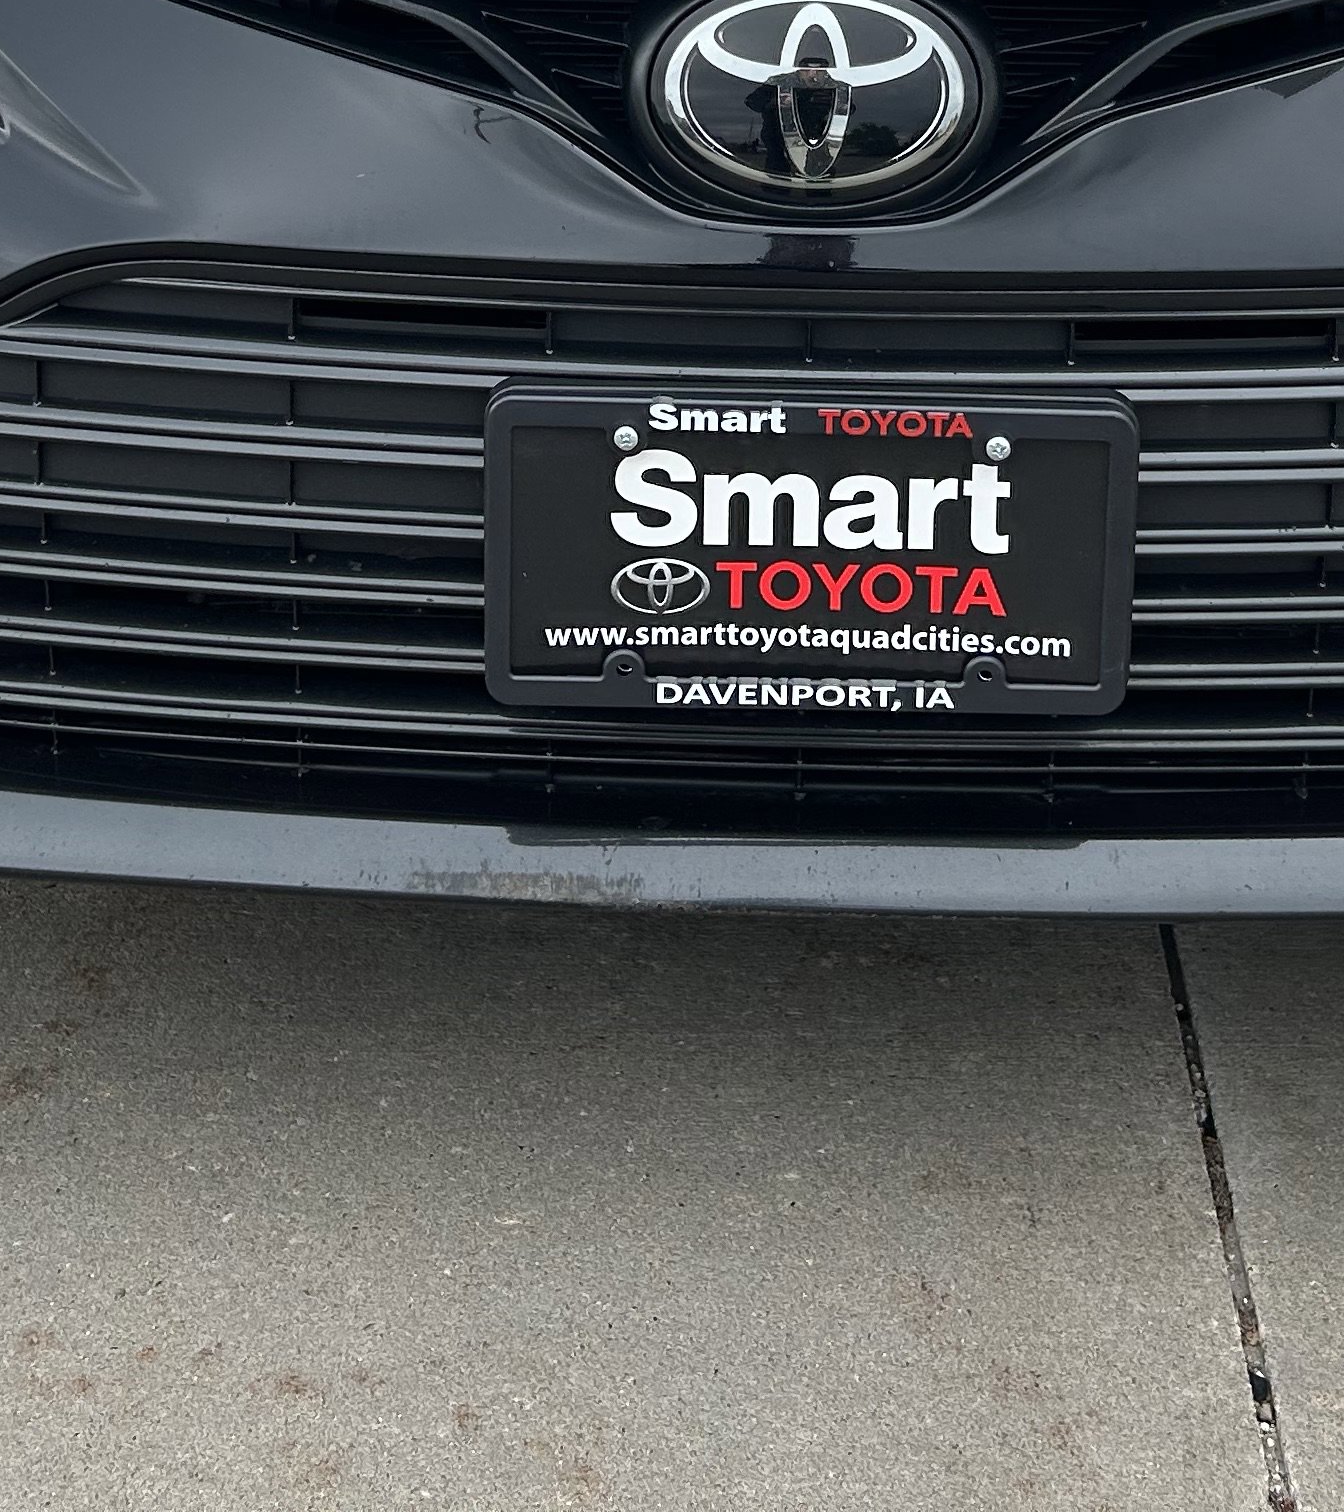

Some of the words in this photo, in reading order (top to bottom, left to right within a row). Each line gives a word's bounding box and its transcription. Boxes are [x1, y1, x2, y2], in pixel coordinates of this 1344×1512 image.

[648, 402, 787, 435] Smart
[818, 409, 973, 438] TOYOTA
[610, 450, 1011, 555] Smart
[716, 560, 1007, 617] TOYOTA
[544, 624, 1071, 658] www.smarttoyotaquadcities.com
[656, 683, 902, 712] DAVENPORT,
[915, 687, 955, 709] IA
